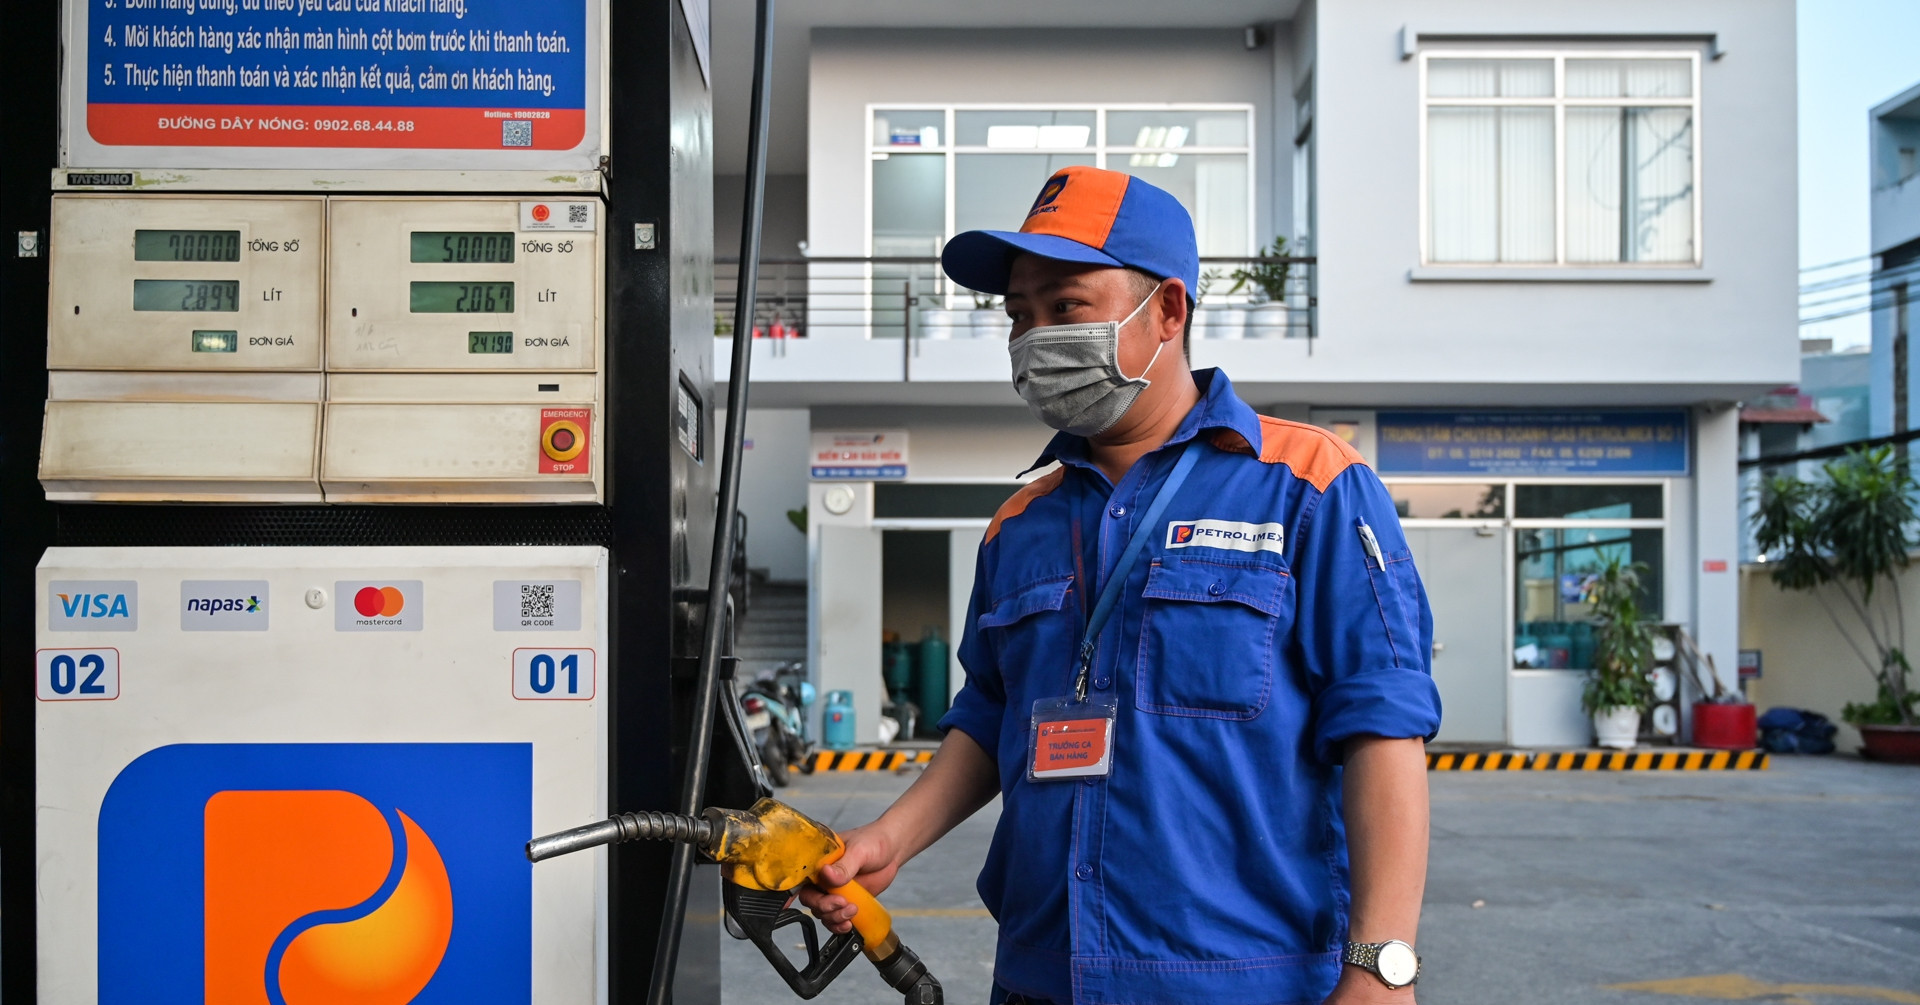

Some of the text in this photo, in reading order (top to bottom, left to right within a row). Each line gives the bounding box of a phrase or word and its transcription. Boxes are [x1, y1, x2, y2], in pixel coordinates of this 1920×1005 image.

[104, 24, 571, 55] 4. Mời khách hàng xác nhận màn hình cột bơm trước khi thanh toán.
[104, 63, 556, 97] 5. Thực hiện thanh toán và xác nhận kết quả, cảm ơn khách hàng.
[484, 110, 551, 119] Hotline: 19002828
[158, 115, 415, 132] ĐƯỜNG DÂY NÓNG: 0902.68.44.88
[70, 174, 130, 185] TATSUNO
[169, 234, 237, 261] 70000
[247, 237, 300, 252] TỔNG SỐ
[442, 235, 512, 262] 50000
[521, 239, 574, 253] TỔNG SỐ
[181, 284, 237, 311] 2.894
[263, 287, 283, 301] LÍT
[456, 285, 511, 312] 2.067
[538, 288, 557, 302] LÍT
[249, 335, 294, 346] ĐƠN GIÁ
[472, 335, 512, 353] 24190
[525, 336, 570, 347] ĐƠN GIÁ
[543, 410, 589, 418] EMERGENCY
[553, 464, 575, 472] STOP
[1196, 528, 1283, 544] PETROLIMEX
[56, 593, 129, 618] VISA
[187, 598, 244, 616] napas
[356, 618, 403, 626] mastercard
[521, 619, 554, 627] QR CODE
[50, 654, 105, 695] 02
[529, 653, 578, 694] 01
